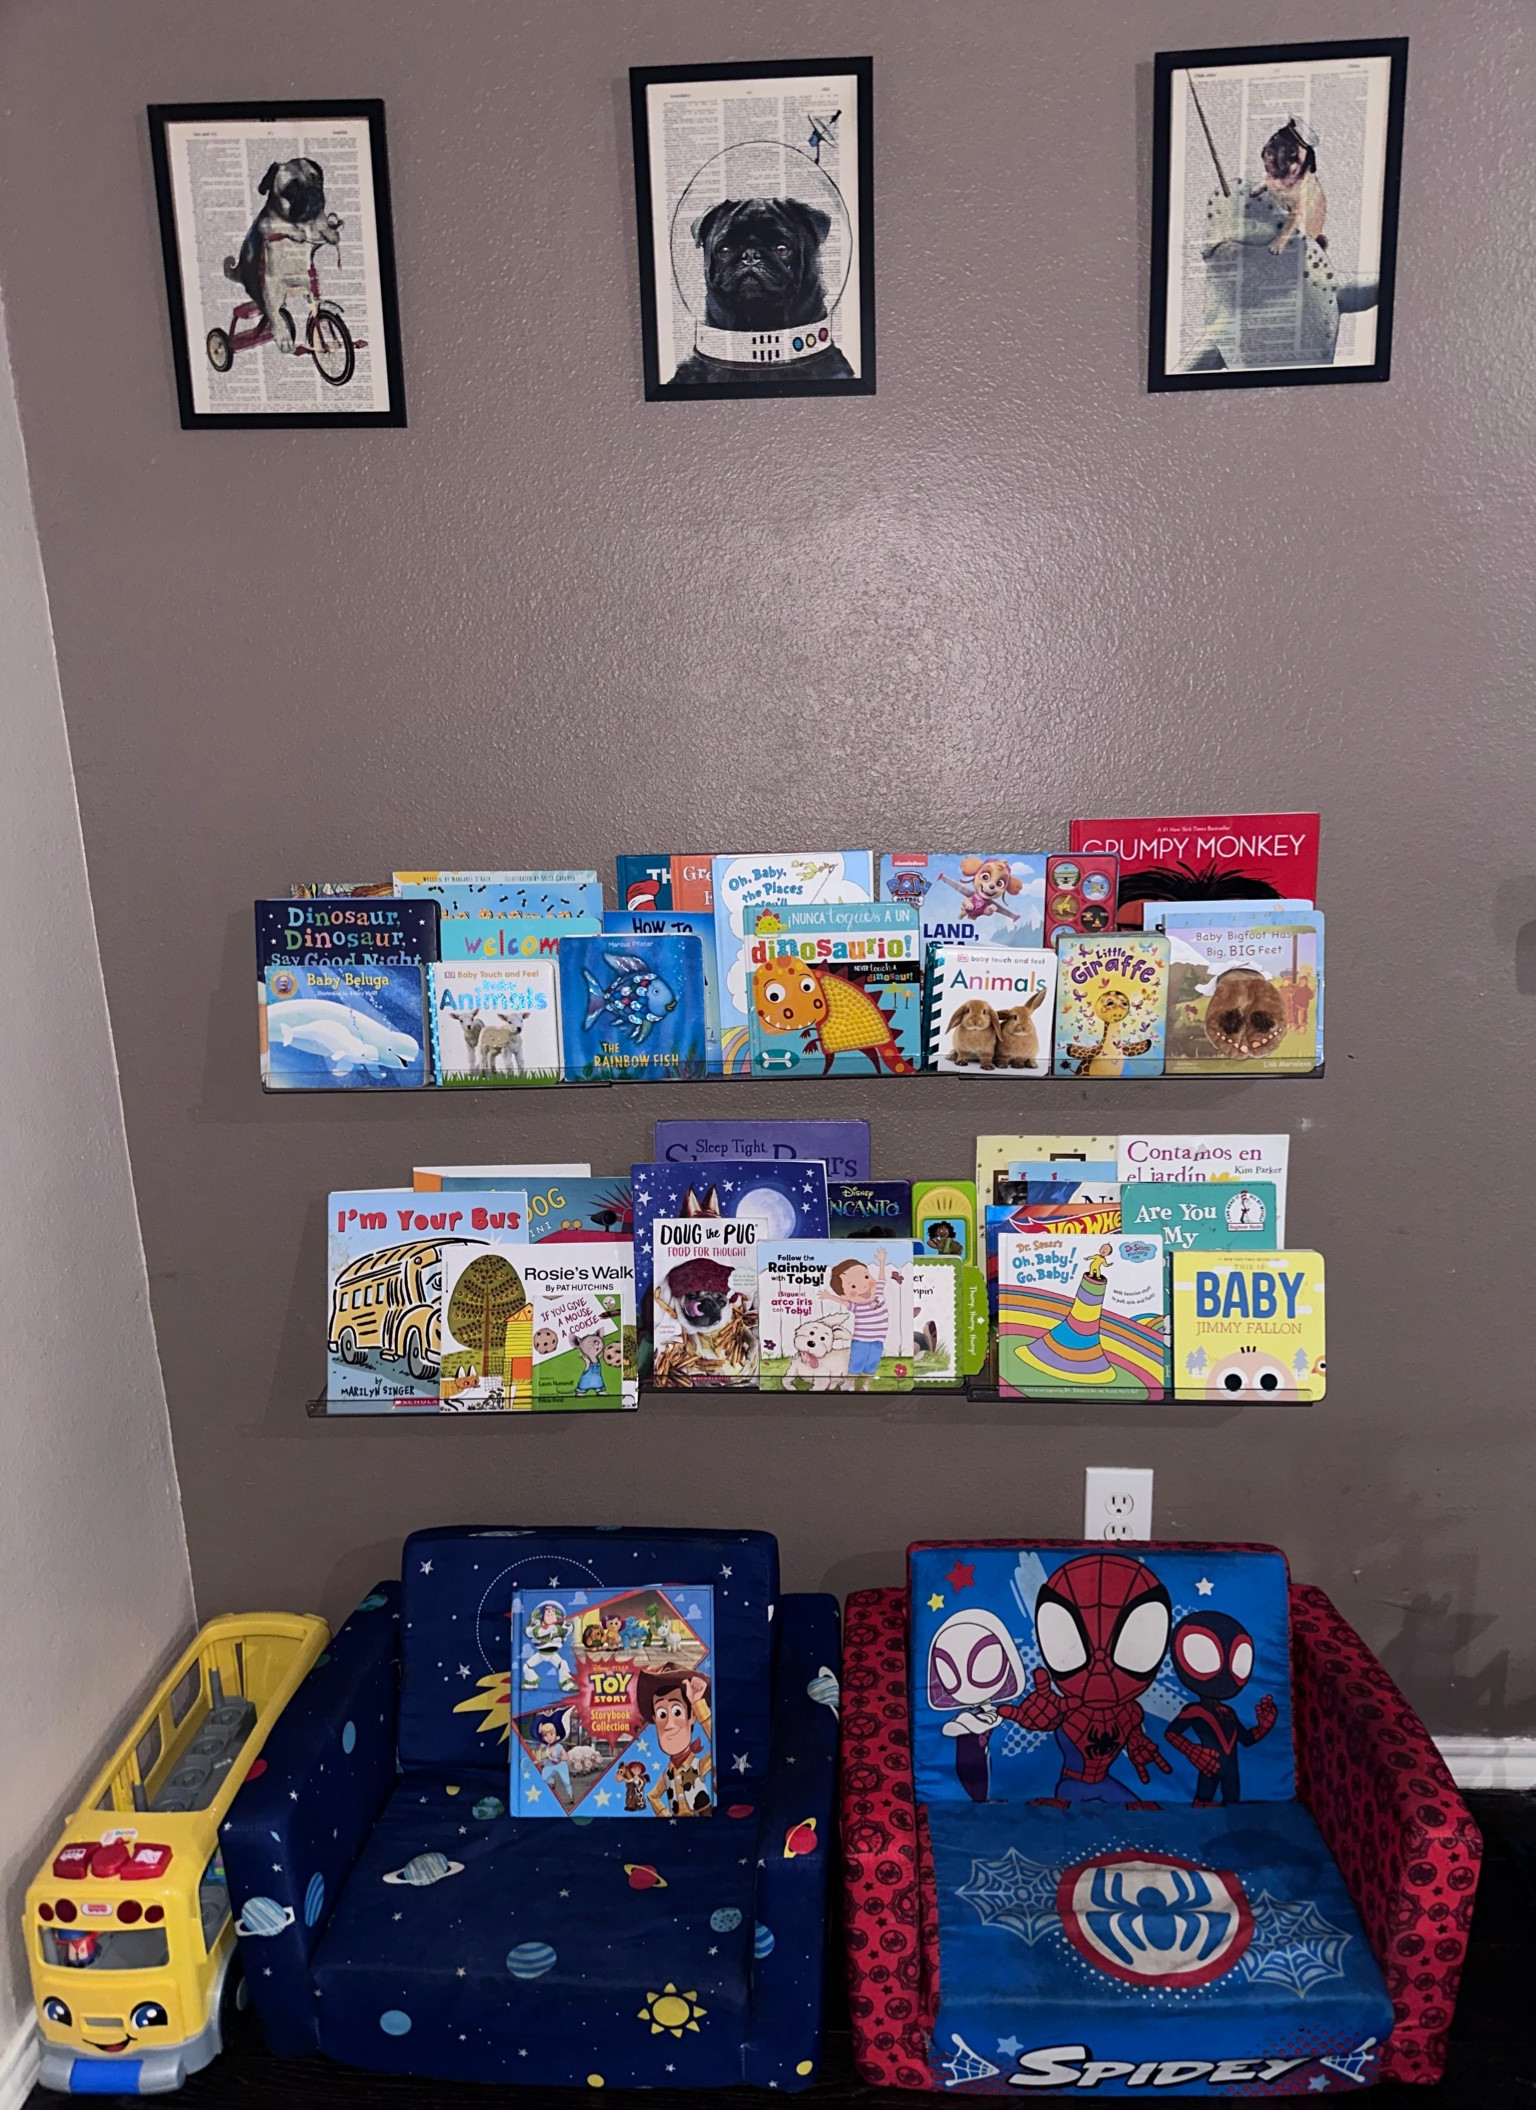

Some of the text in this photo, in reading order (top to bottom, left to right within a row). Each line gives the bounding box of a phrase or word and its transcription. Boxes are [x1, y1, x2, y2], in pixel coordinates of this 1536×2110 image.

[1196, 833, 1307, 859] MONKEY
[742, 890, 762, 903] the
[762, 882, 803, 898] Places
[886, 878, 932, 895] PAW
[288, 906, 400, 928] Dinosaur,
[884, 910, 892, 922] A
[896, 910, 910, 922] UN
[284, 928, 406, 950] Dinosaur,
[924, 924, 979, 941] LAND,
[1196, 929, 1291, 943] Baby Bigfoot Has
[752, 934, 912, 964] dinosaurio!
[1096, 948, 1126, 960] Little
[1230, 944, 1255, 956] BIG
[1258, 945, 1282, 954] Feet
[304, 952, 356, 966] Good
[458, 971, 478, 980] Baby
[522, 970, 539, 978] Feel
[870, 964, 892, 972] touch
[1071, 955, 1156, 984] Giraffe
[306, 972, 390, 990] Baby Beluga
[867, 972, 914, 982] dinosaur!
[950, 969, 1048, 992] Animals
[440, 986, 547, 1010] Animals
[602, 1043, 620, 1053] THE
[594, 1054, 680, 1068] RAINBOW FISH
[696, 1139, 728, 1157] Sleep
[732, 1139, 768, 1157] Tight,
[1128, 1140, 1262, 1162] Contamos en
[1128, 1165, 1206, 1182] el jardín
[1234, 1166, 1282, 1175] Kim Parker
[828, 1198, 902, 1217] NCANTO
[1134, 1203, 1218, 1224] Are You
[338, 1207, 521, 1232] I'm Your Bus
[660, 1224, 702, 1245] DOUG
[706, 1228, 720, 1240] the
[1162, 1226, 1200, 1249] My
[668, 1246, 747, 1257] FOOD FOR THOUGHT
[1016, 1240, 1063, 1254] Dr. Seuss's
[1035, 1247, 1078, 1264] Baby!
[524, 1266, 634, 1280] Rosie's Walk
[768, 1262, 828, 1273] Rainbow
[1036, 1264, 1078, 1284] Baby!
[546, 1284, 555, 1292] By
[786, 1273, 824, 1286] Toby!
[1196, 1271, 1305, 1319] BABY
[540, 1297, 587, 1322] IF YOU GIVE
[558, 1307, 593, 1327] A MOUSE
[784, 1306, 812, 1316] Toby!
[562, 1314, 600, 1338] A COOKIE
[1196, 1322, 1302, 1336] JIMMY FALLON
[375, 1376, 382, 1387] by
[382, 1386, 414, 1396] SINGER
[591, 1709, 630, 1722] Storybook
[592, 1721, 630, 1732] Collection
[1009, 2046, 1318, 2086] SPIDEY
